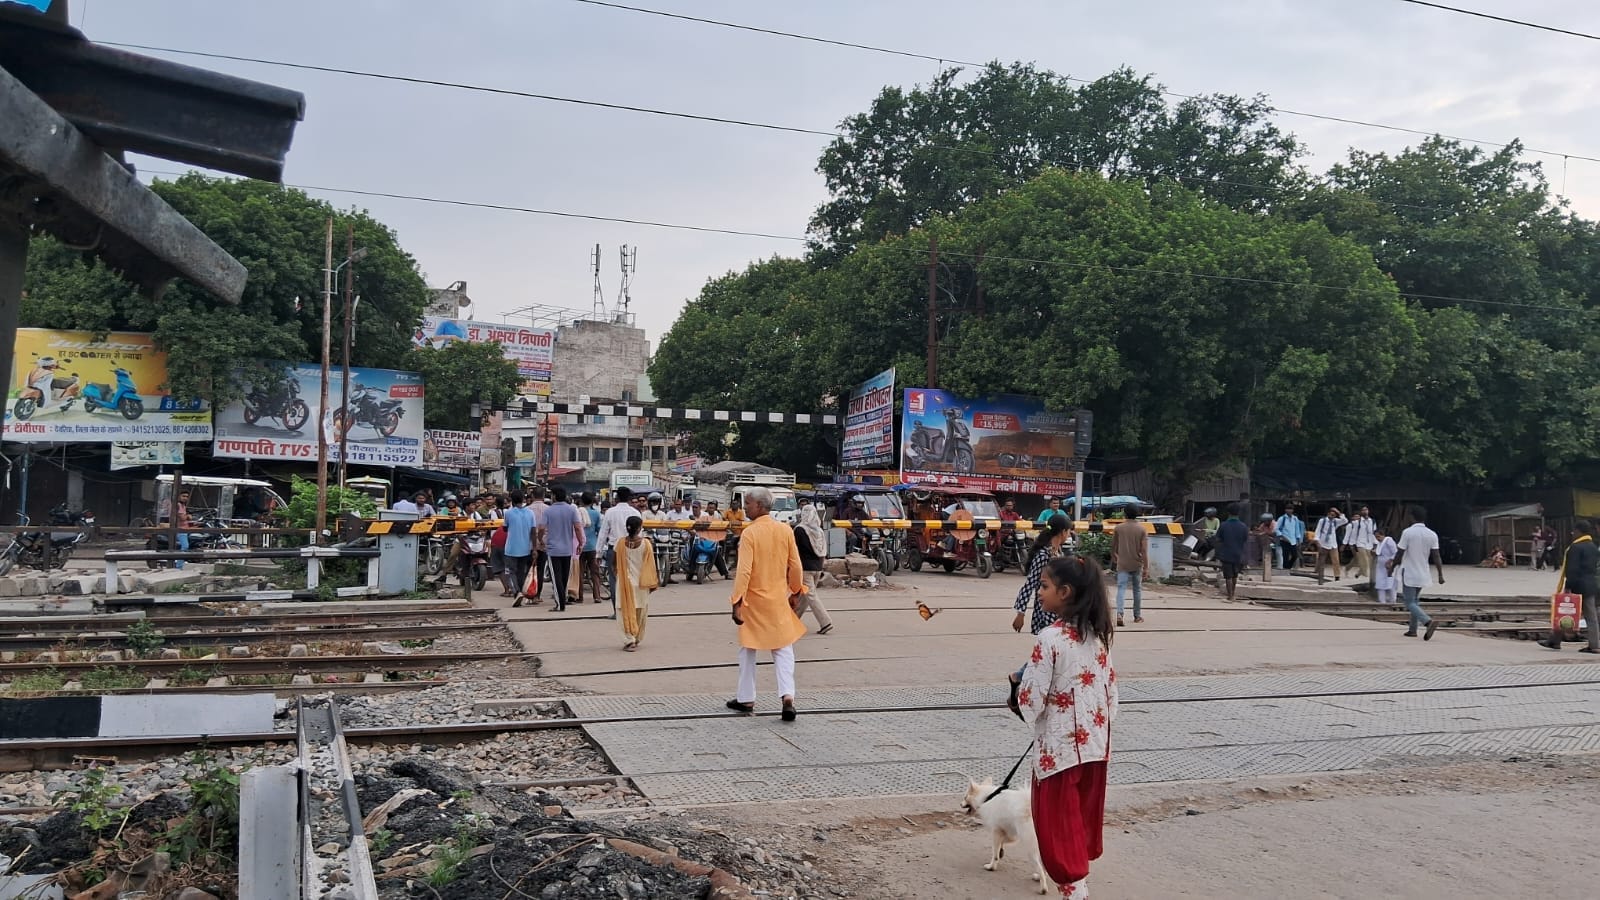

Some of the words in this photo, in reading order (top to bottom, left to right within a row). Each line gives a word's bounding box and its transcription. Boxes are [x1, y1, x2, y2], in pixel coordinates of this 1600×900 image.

[518, 329, 551, 347] त्रिपाठी
[432, 431, 480, 441] ELEPHAN
[218, 439, 276, 455] गणपति
[280, 443, 311, 456] TVS
[437, 439, 469, 448] HOTEL
[384, 446, 418, 455] देवरिया
